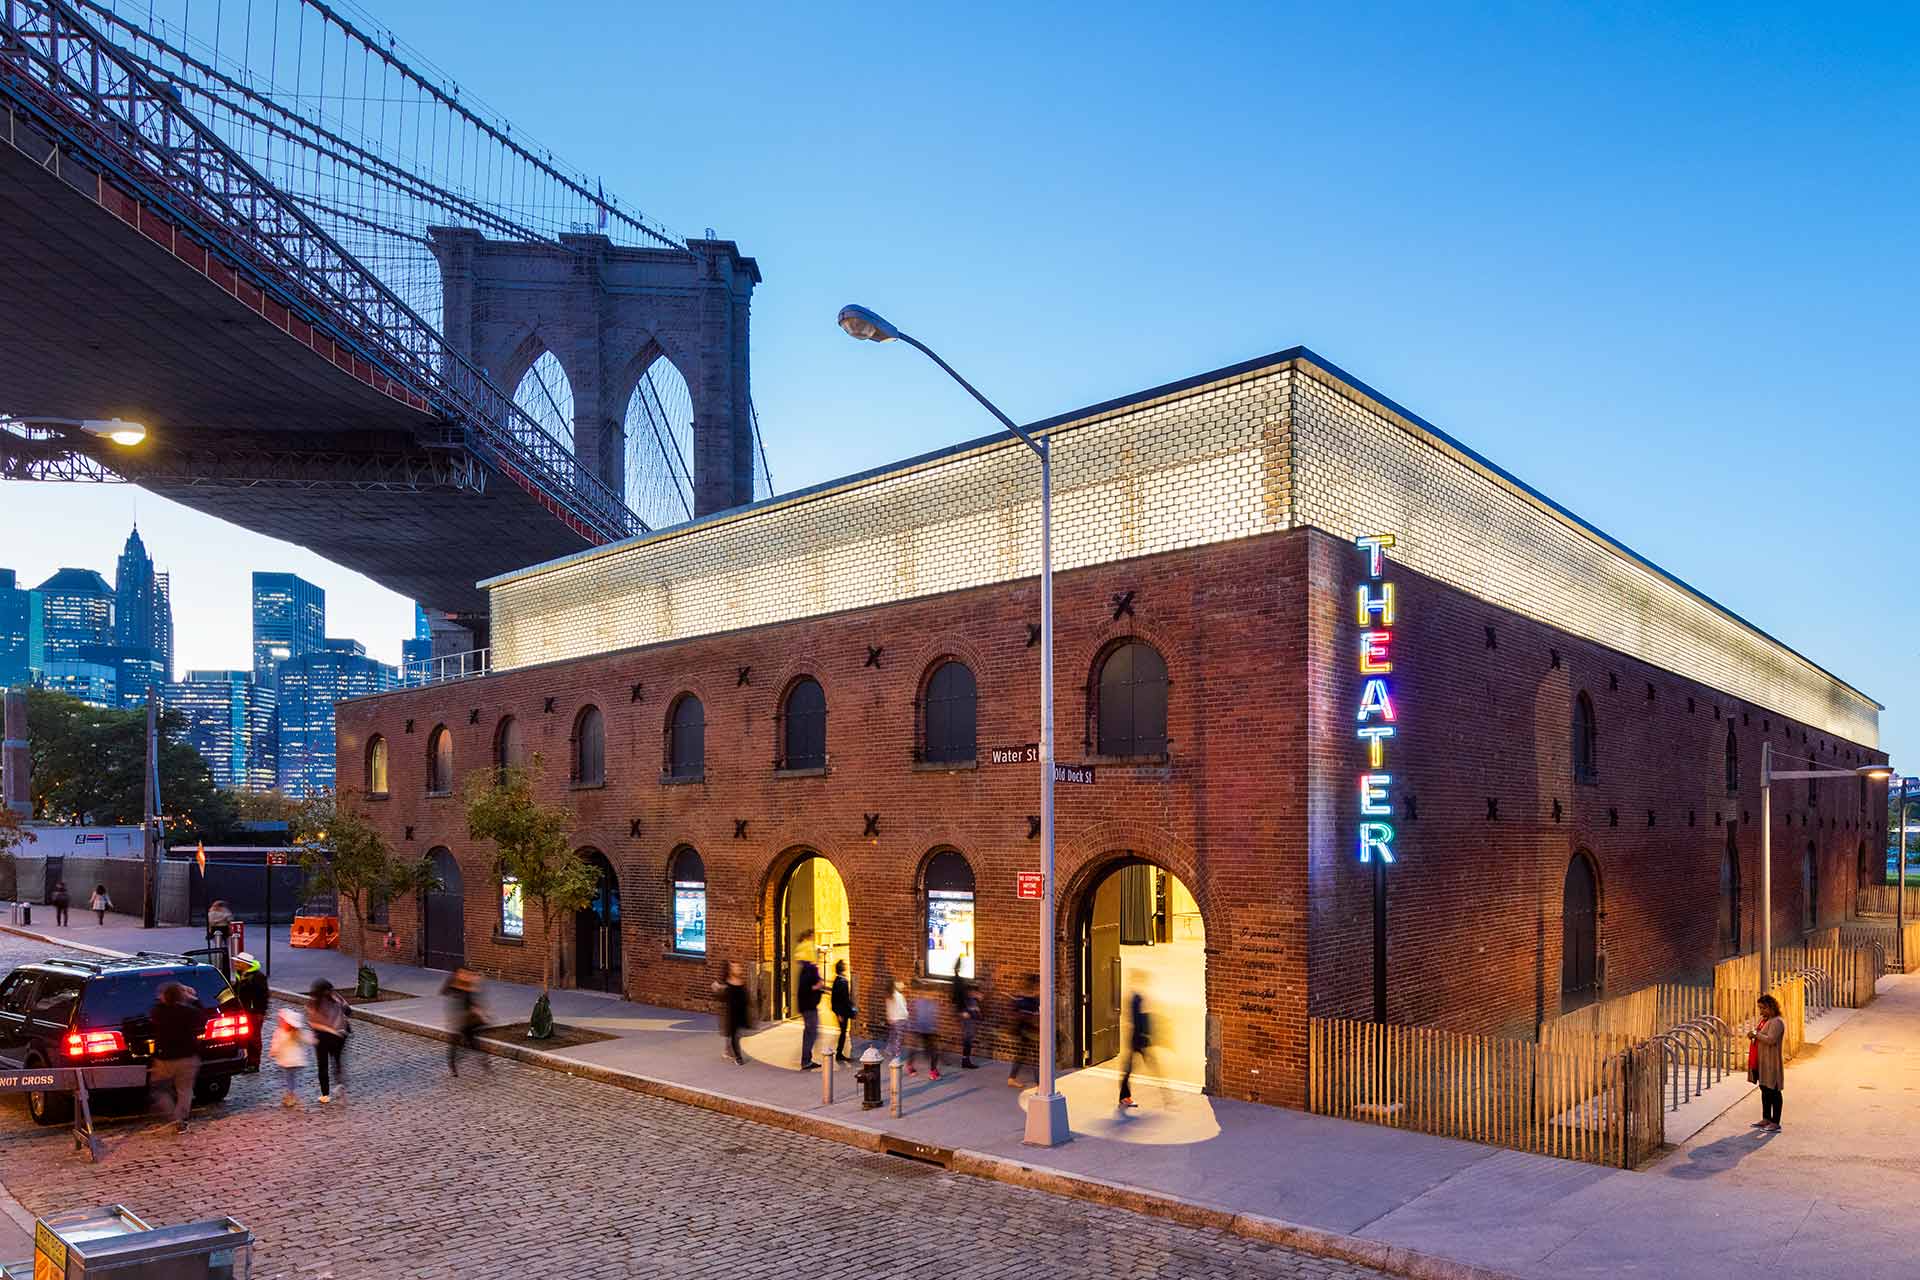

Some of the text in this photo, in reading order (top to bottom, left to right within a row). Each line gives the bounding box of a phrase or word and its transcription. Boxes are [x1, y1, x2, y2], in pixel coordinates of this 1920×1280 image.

[1355, 534, 1397, 864] THEATER
[992, 748, 1037, 763] Water St
[1055, 767, 1092, 784] Old Dock St
[0, 1075, 54, 1087] NOT CROSS
